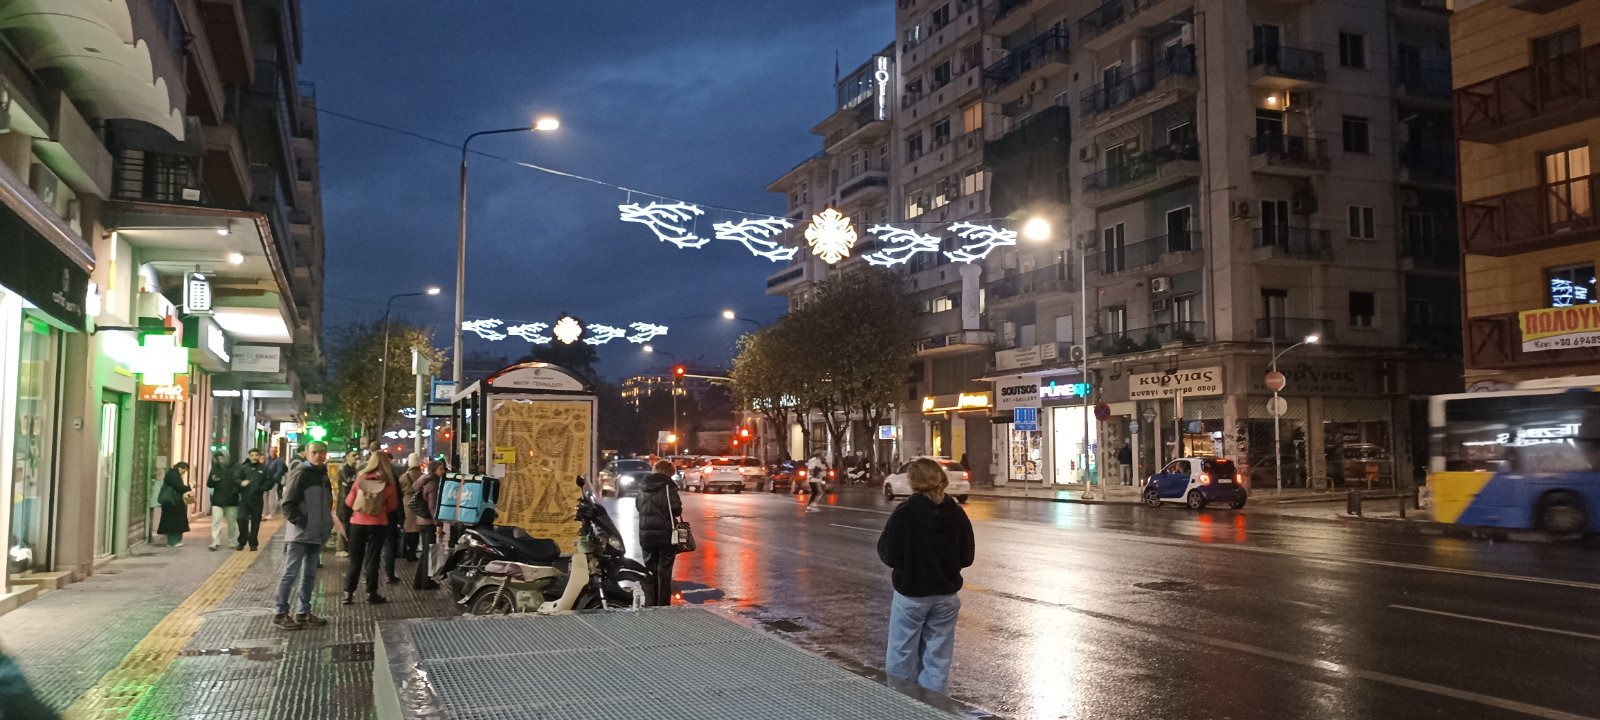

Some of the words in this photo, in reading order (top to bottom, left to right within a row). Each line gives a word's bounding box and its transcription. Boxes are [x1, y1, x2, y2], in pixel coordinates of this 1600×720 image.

[875, 56, 889, 120] HOTEL
[1554, 338, 1571, 346] +30
[1000, 384, 1037, 396] SOUTSOS
